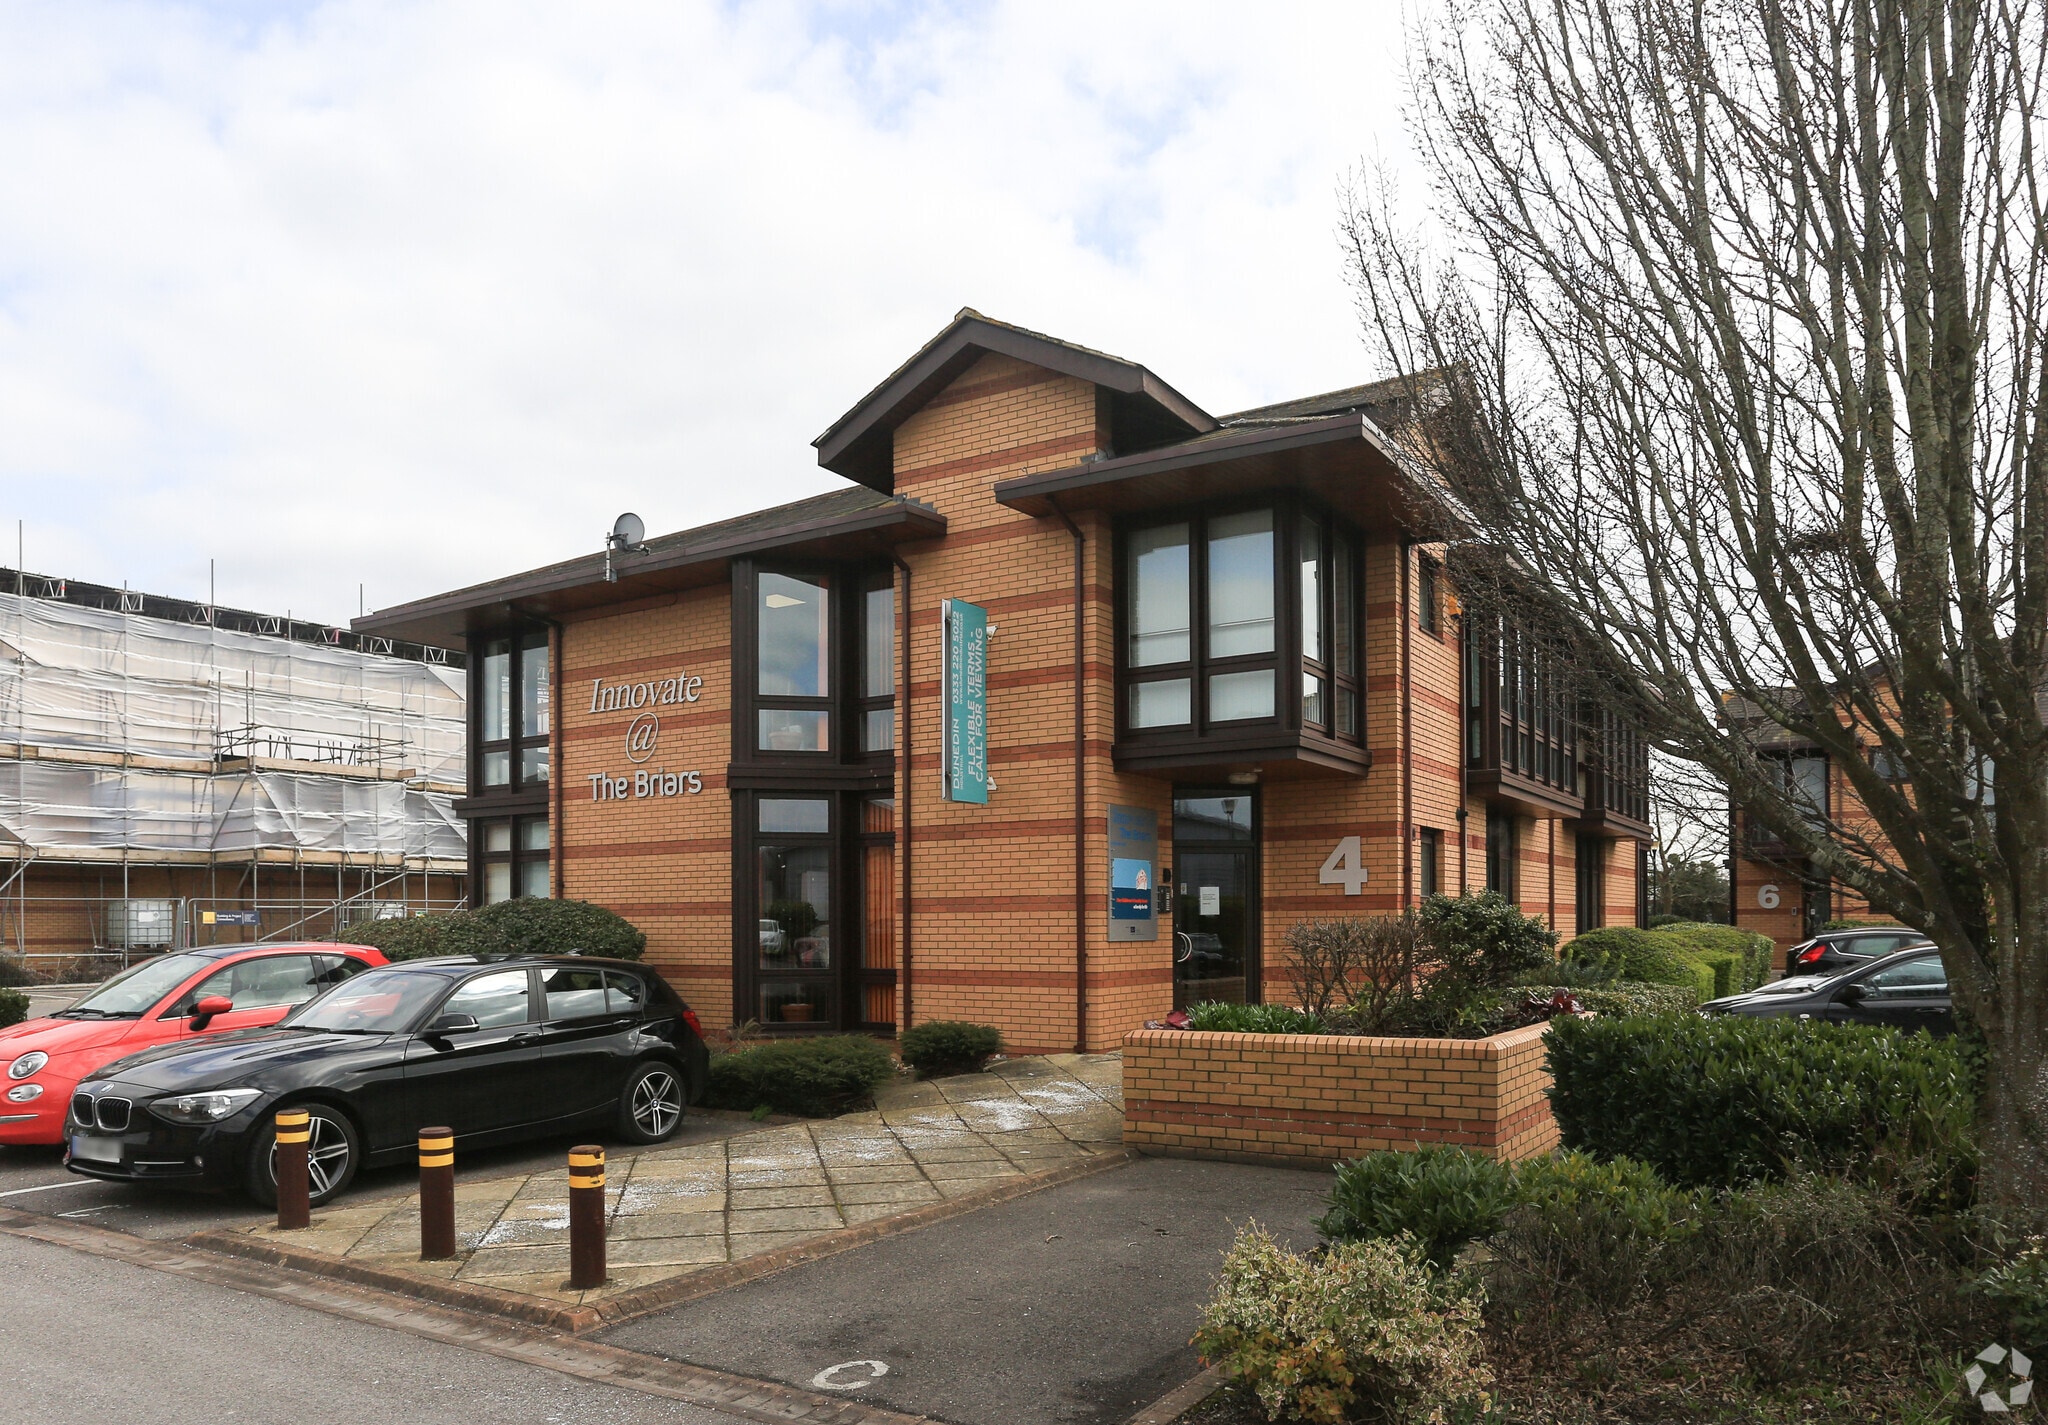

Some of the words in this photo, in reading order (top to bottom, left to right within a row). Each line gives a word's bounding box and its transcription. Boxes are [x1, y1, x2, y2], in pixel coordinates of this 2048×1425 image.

[967, 641, 975, 696] TERMS
[974, 627, 983, 699] VIEWING
[588, 670, 702, 714] Innovate
[625, 712, 660, 763] @
[967, 699, 975, 776] FLEXIBLE
[975, 703, 983, 737] FOR
[975, 741, 983, 782] CALL
[588, 771, 628, 802] The
[634, 766, 702, 798] Briars
[1319, 836, 1368, 895] 4
[1758, 884, 1780, 909] 6
[812, 1360, 890, 1390] C
